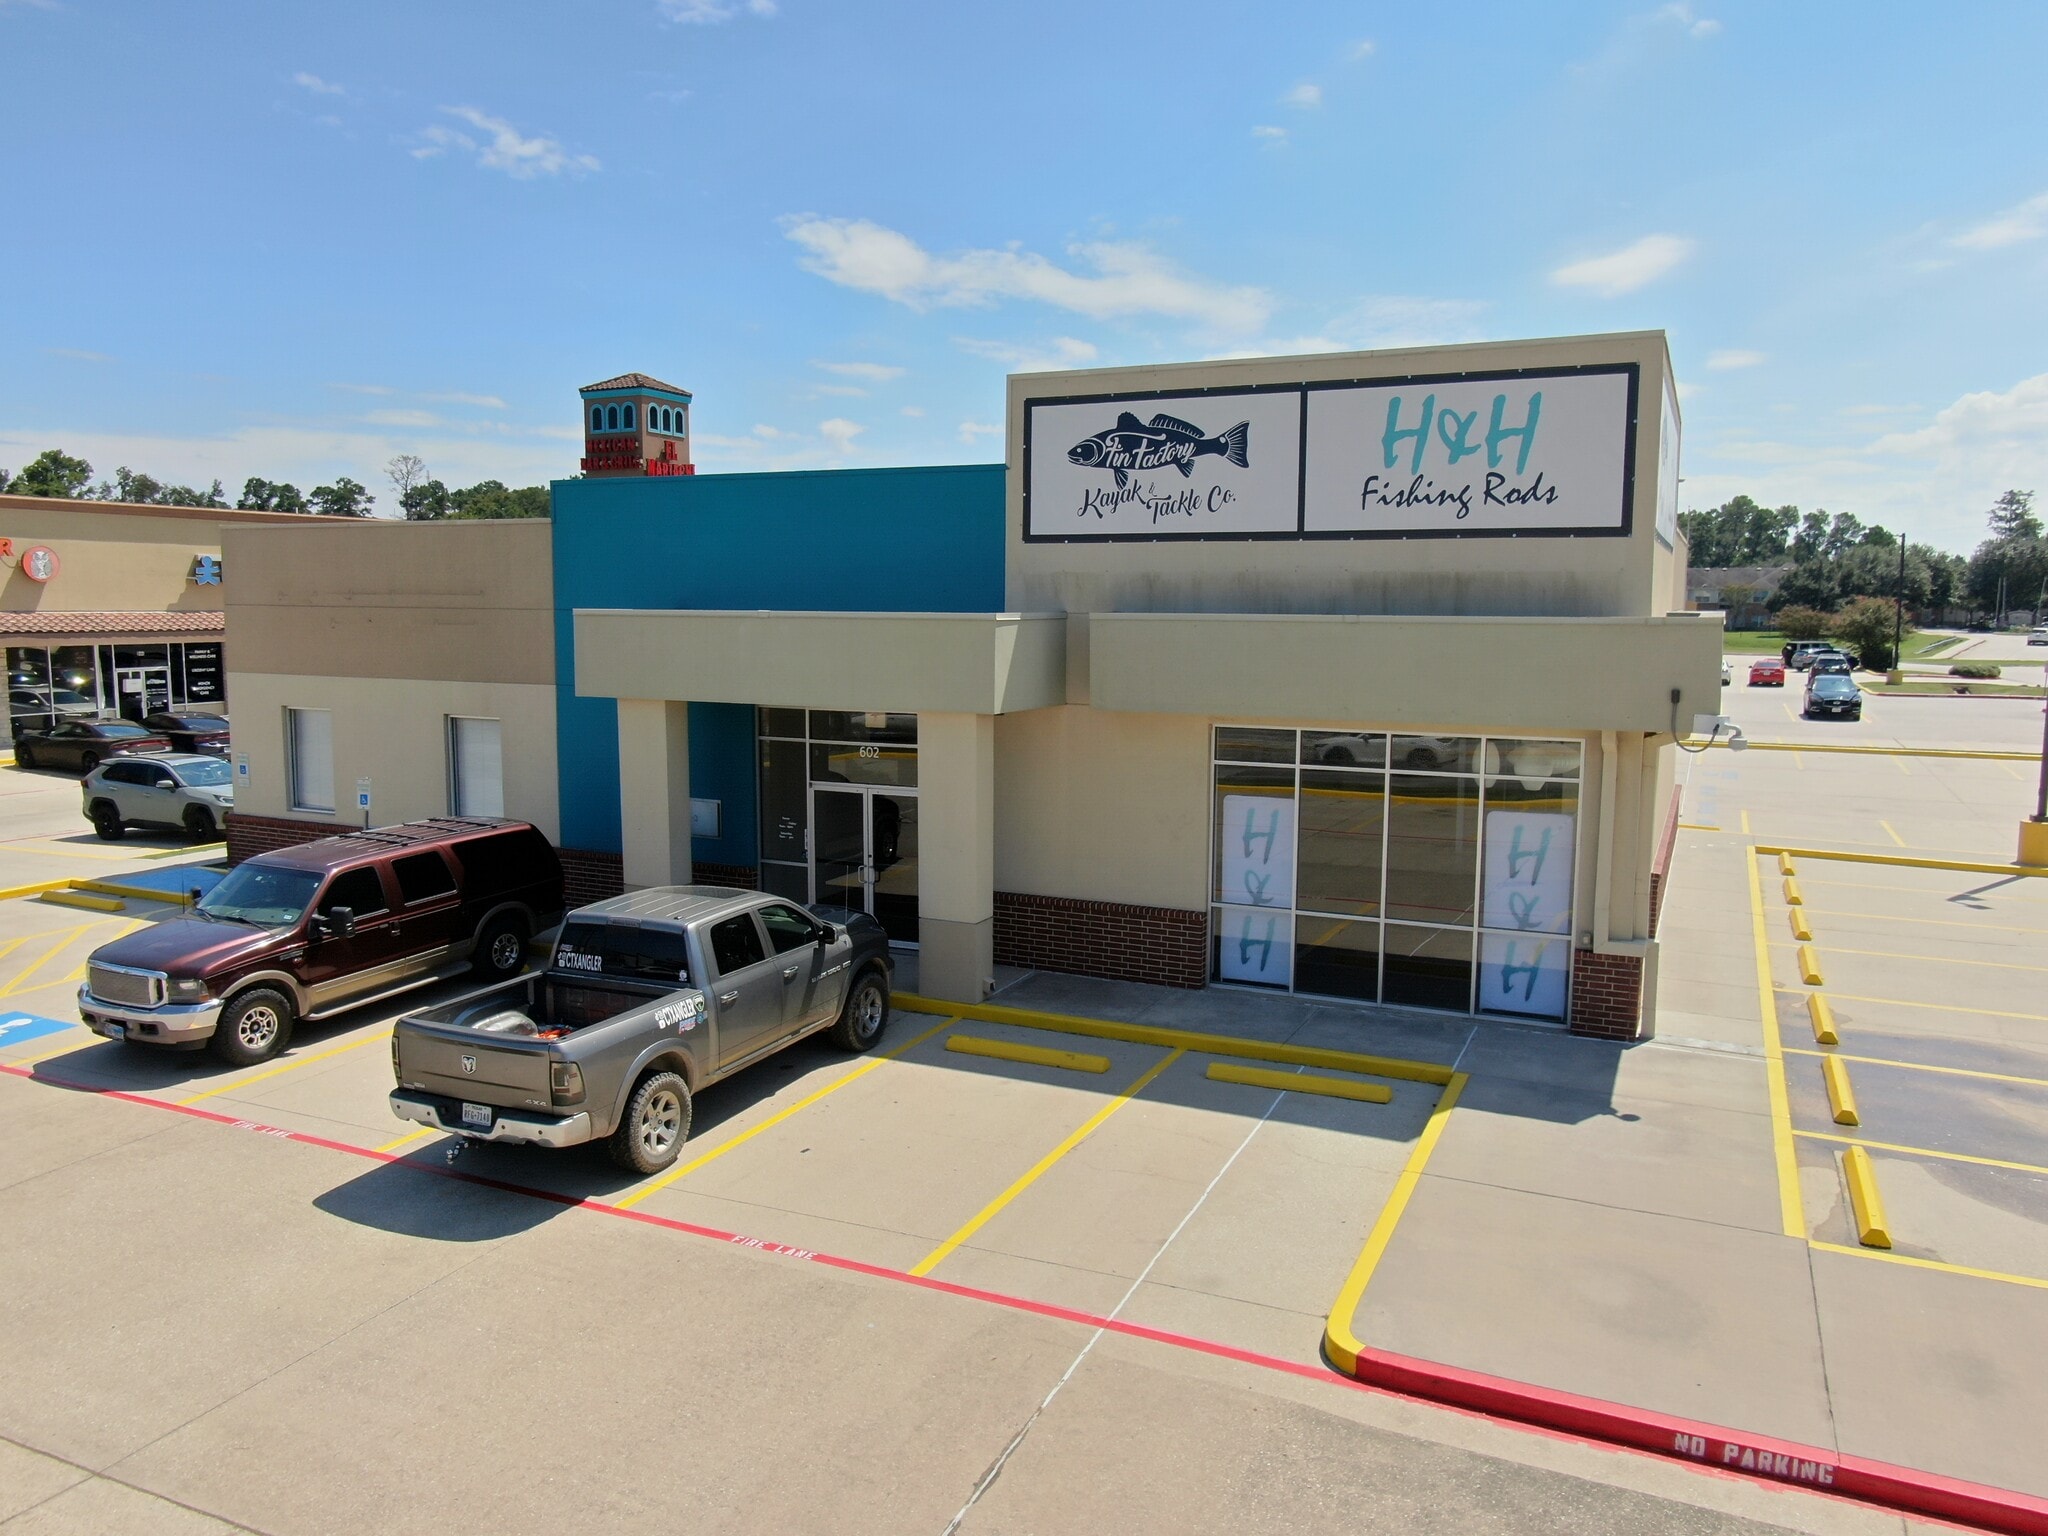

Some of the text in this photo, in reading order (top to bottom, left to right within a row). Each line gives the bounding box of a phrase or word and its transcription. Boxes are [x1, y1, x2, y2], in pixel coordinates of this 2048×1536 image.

[587, 439, 636, 453] MEXICAN
[1382, 391, 1542, 475] H&H
[664, 440, 678, 460] EL
[1131, 432, 1196, 469] Factory
[1077, 479, 1146, 519] Kayak
[1147, 488, 1202, 524] Tackle
[1207, 485, 1236, 513] Co.
[1361, 472, 1558, 519] Fishing Rods
[859, 746, 880, 759] 602
[565, 952, 603, 972] CTXANGLER
[731, 1235, 818, 1260] FIRE LANE
[1675, 1433, 1834, 1484] NO PARKING
